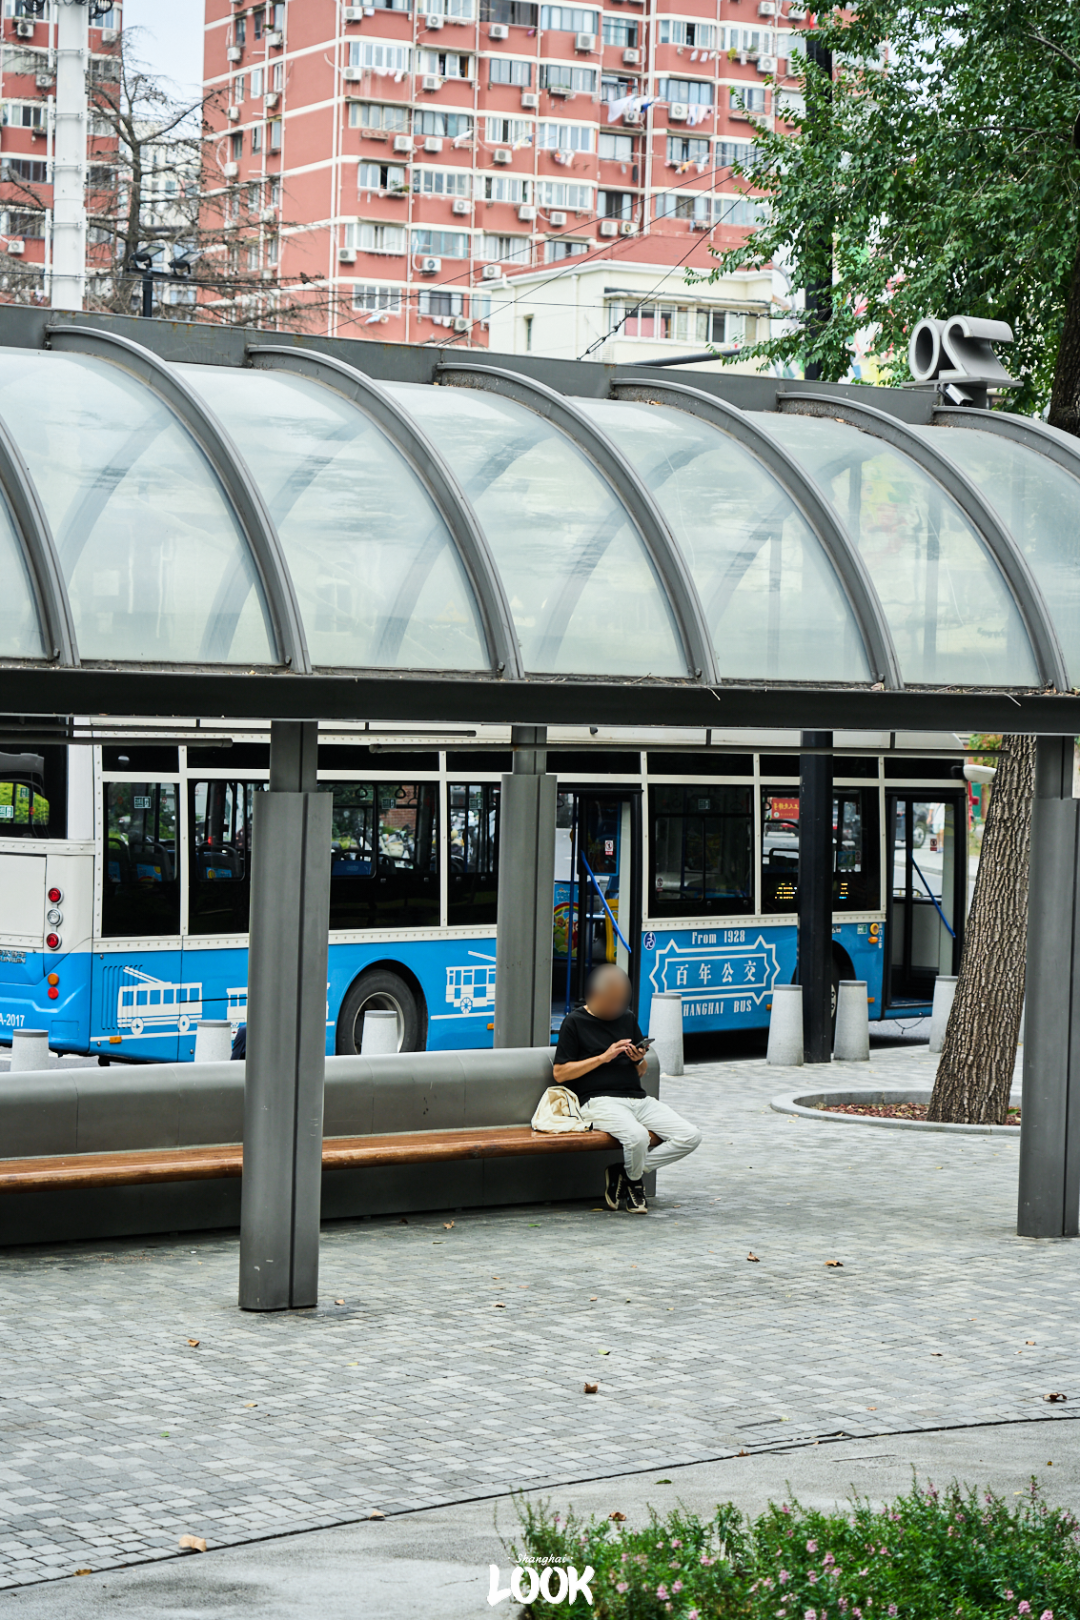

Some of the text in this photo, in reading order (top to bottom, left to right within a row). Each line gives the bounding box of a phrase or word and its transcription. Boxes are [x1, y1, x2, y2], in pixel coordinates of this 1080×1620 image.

[692, 930, 745, 945] From 1928
[675, 960, 757, 986] 百年公交
[681, 1000, 752, 1017] HANGHAI BUS
